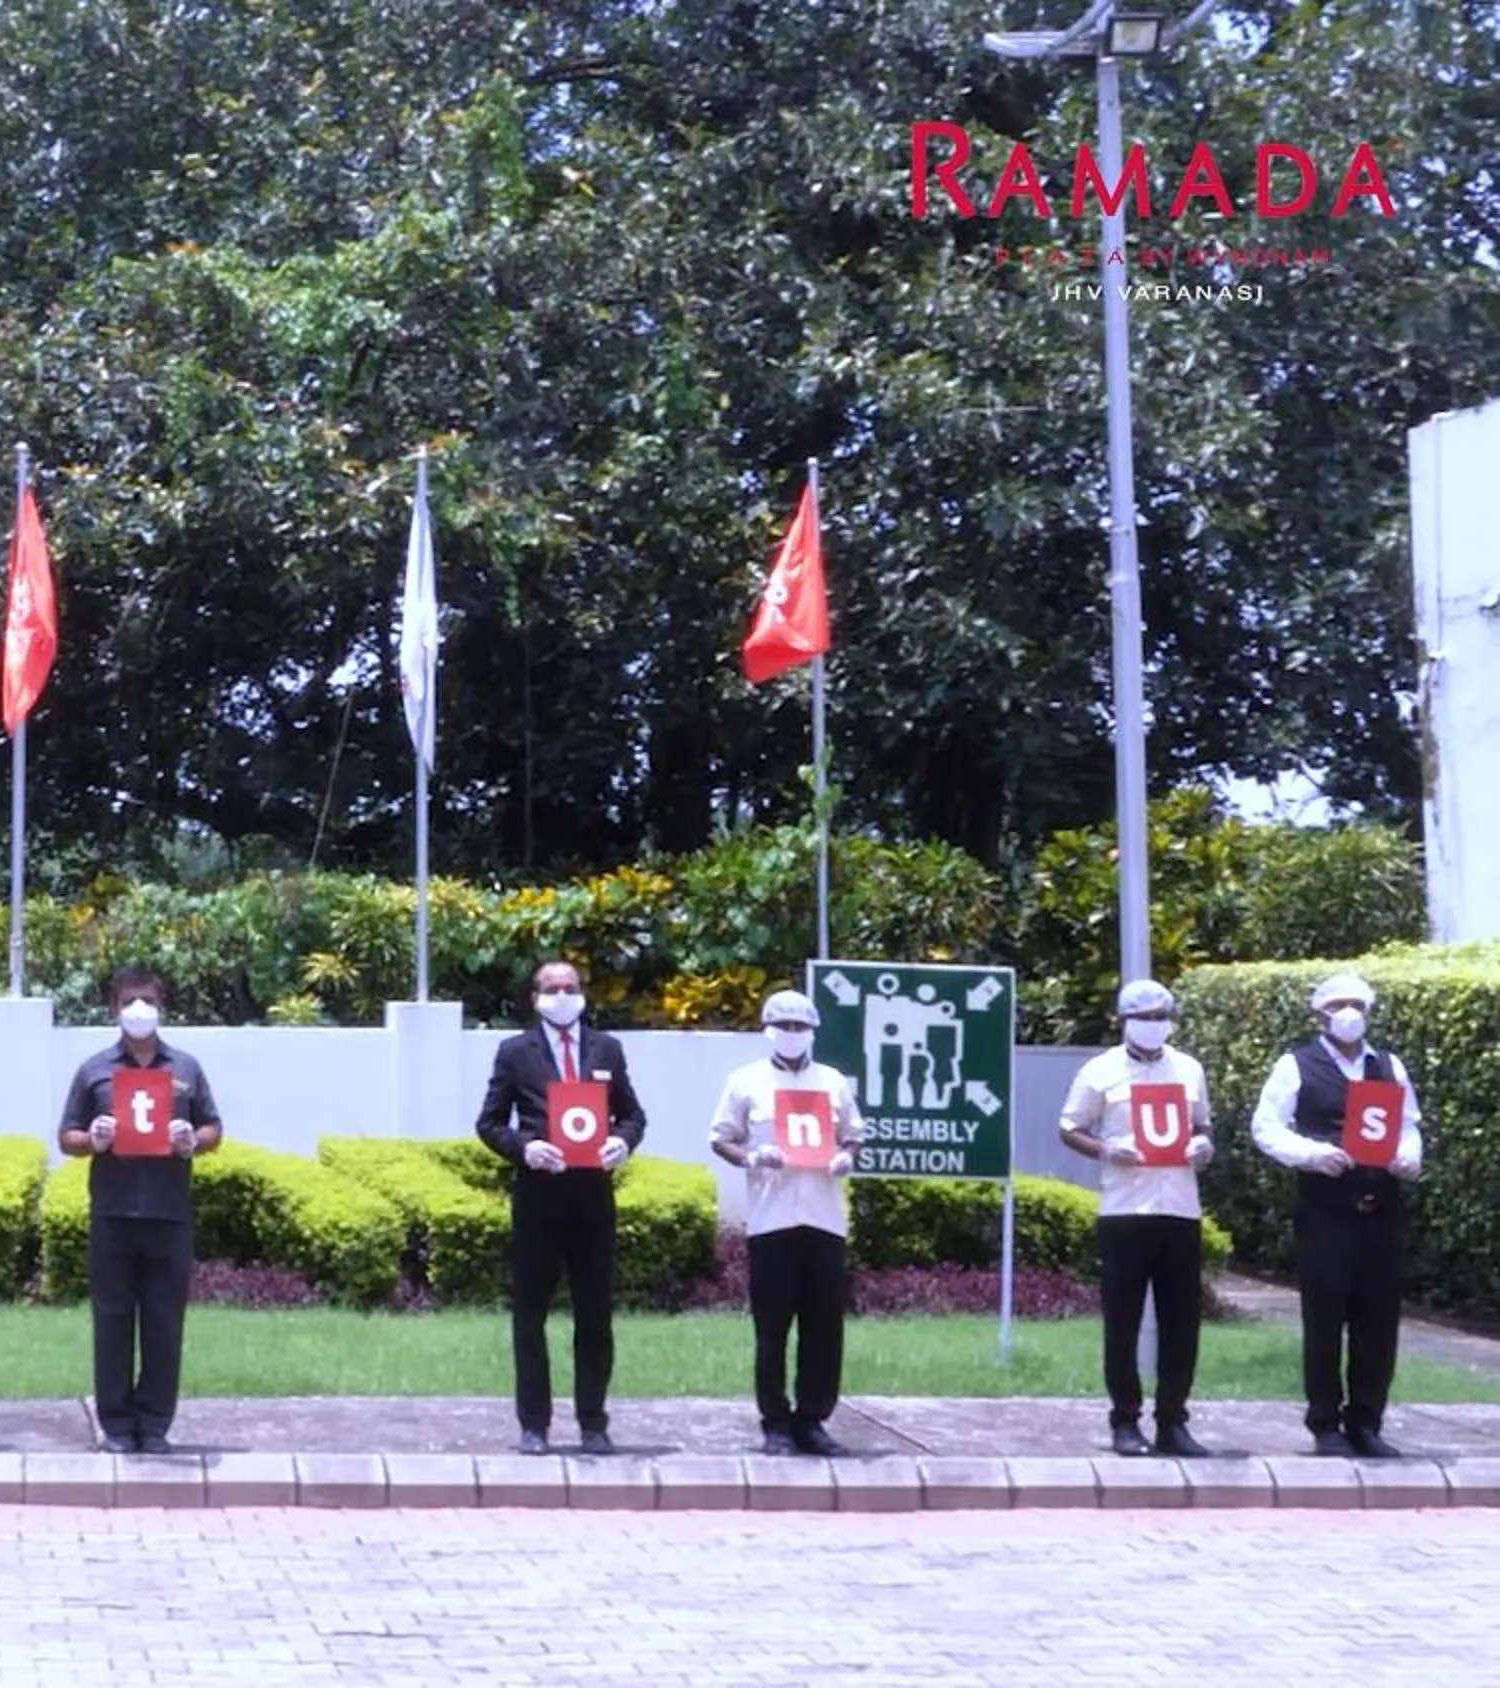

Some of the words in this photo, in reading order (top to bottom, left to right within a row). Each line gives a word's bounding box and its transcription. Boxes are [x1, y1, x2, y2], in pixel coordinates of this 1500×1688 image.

[131, 1089, 157, 1134] t
[786, 1111, 823, 1147] n
[1140, 1102, 1181, 1148] U
[862, 1117, 980, 1143] SSEMBLY
[857, 1147, 966, 1173] STATION
